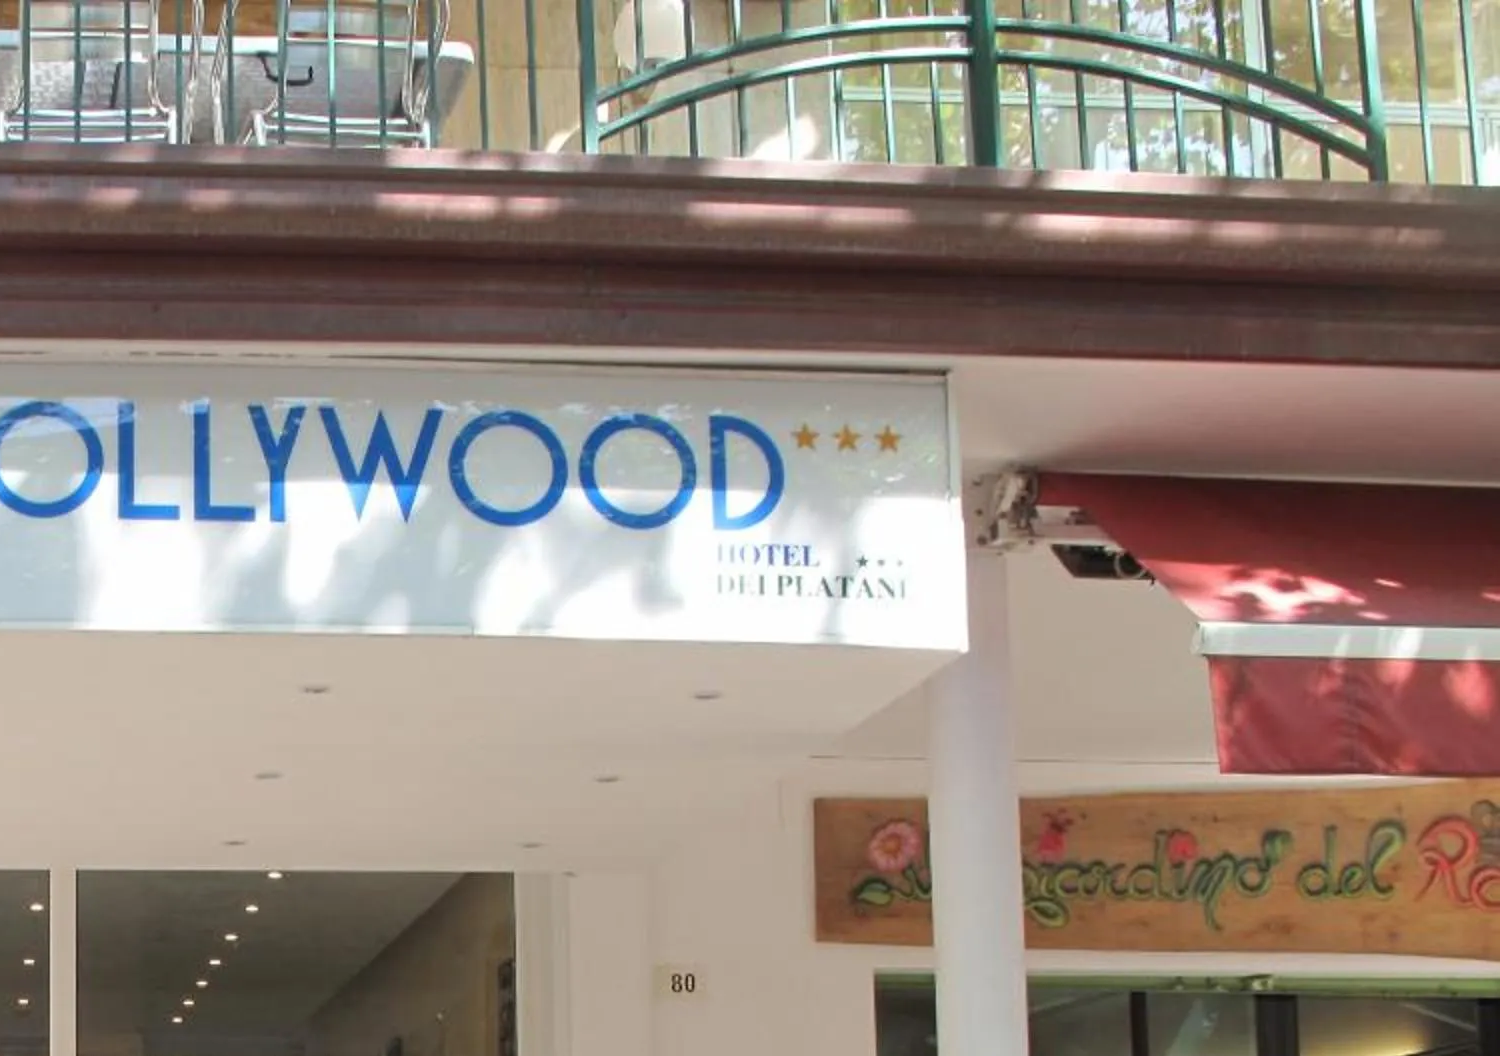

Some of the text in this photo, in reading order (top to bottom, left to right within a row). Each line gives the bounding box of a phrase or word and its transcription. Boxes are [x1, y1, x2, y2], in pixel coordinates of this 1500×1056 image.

[717, 543, 821, 567] HOTEL
[1296, 817, 1407, 899] del
[671, 973, 696, 993] 80
